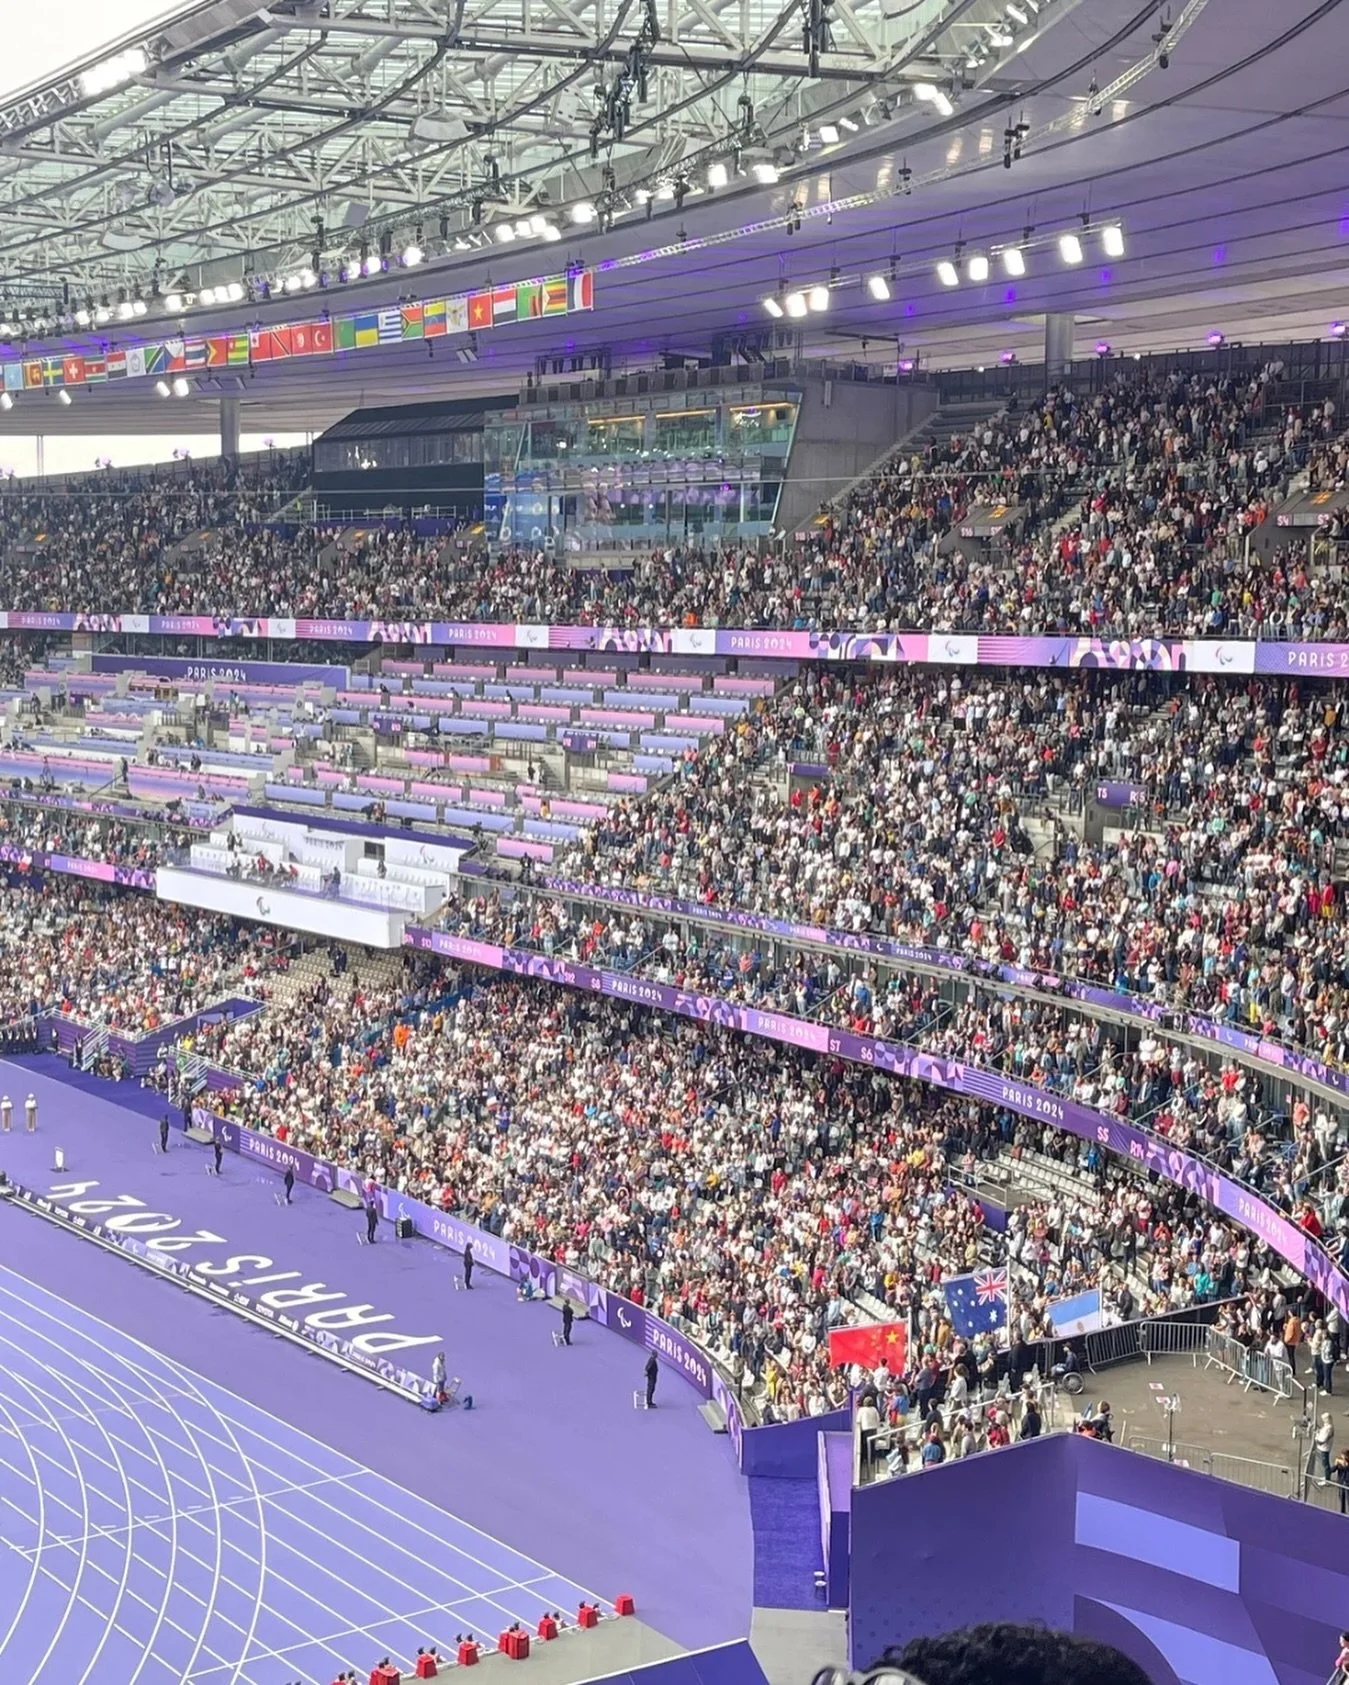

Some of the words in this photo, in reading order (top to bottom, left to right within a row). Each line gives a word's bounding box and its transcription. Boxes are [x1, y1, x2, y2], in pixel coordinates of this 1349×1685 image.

[731, 636, 760, 649] PARIS
[763, 637, 792, 650] 2024
[1288, 651, 1335, 668] PARIS
[611, 980, 637, 995] PARIS
[638, 986, 662, 1001] 2024
[861, 1046, 873, 1060] S6
[1002, 1087, 1033, 1109] PARIS
[1036, 1099, 1064, 1120] 2024
[249, 1138, 275, 1160] PARIS
[276, 1150, 300, 1171] 2024
[45, 1180, 228, 1251] 2024
[433, 1219, 464, 1245] PARIS
[652, 1328, 682, 1364] PARIS
[684, 1352, 707, 1388] 2024
